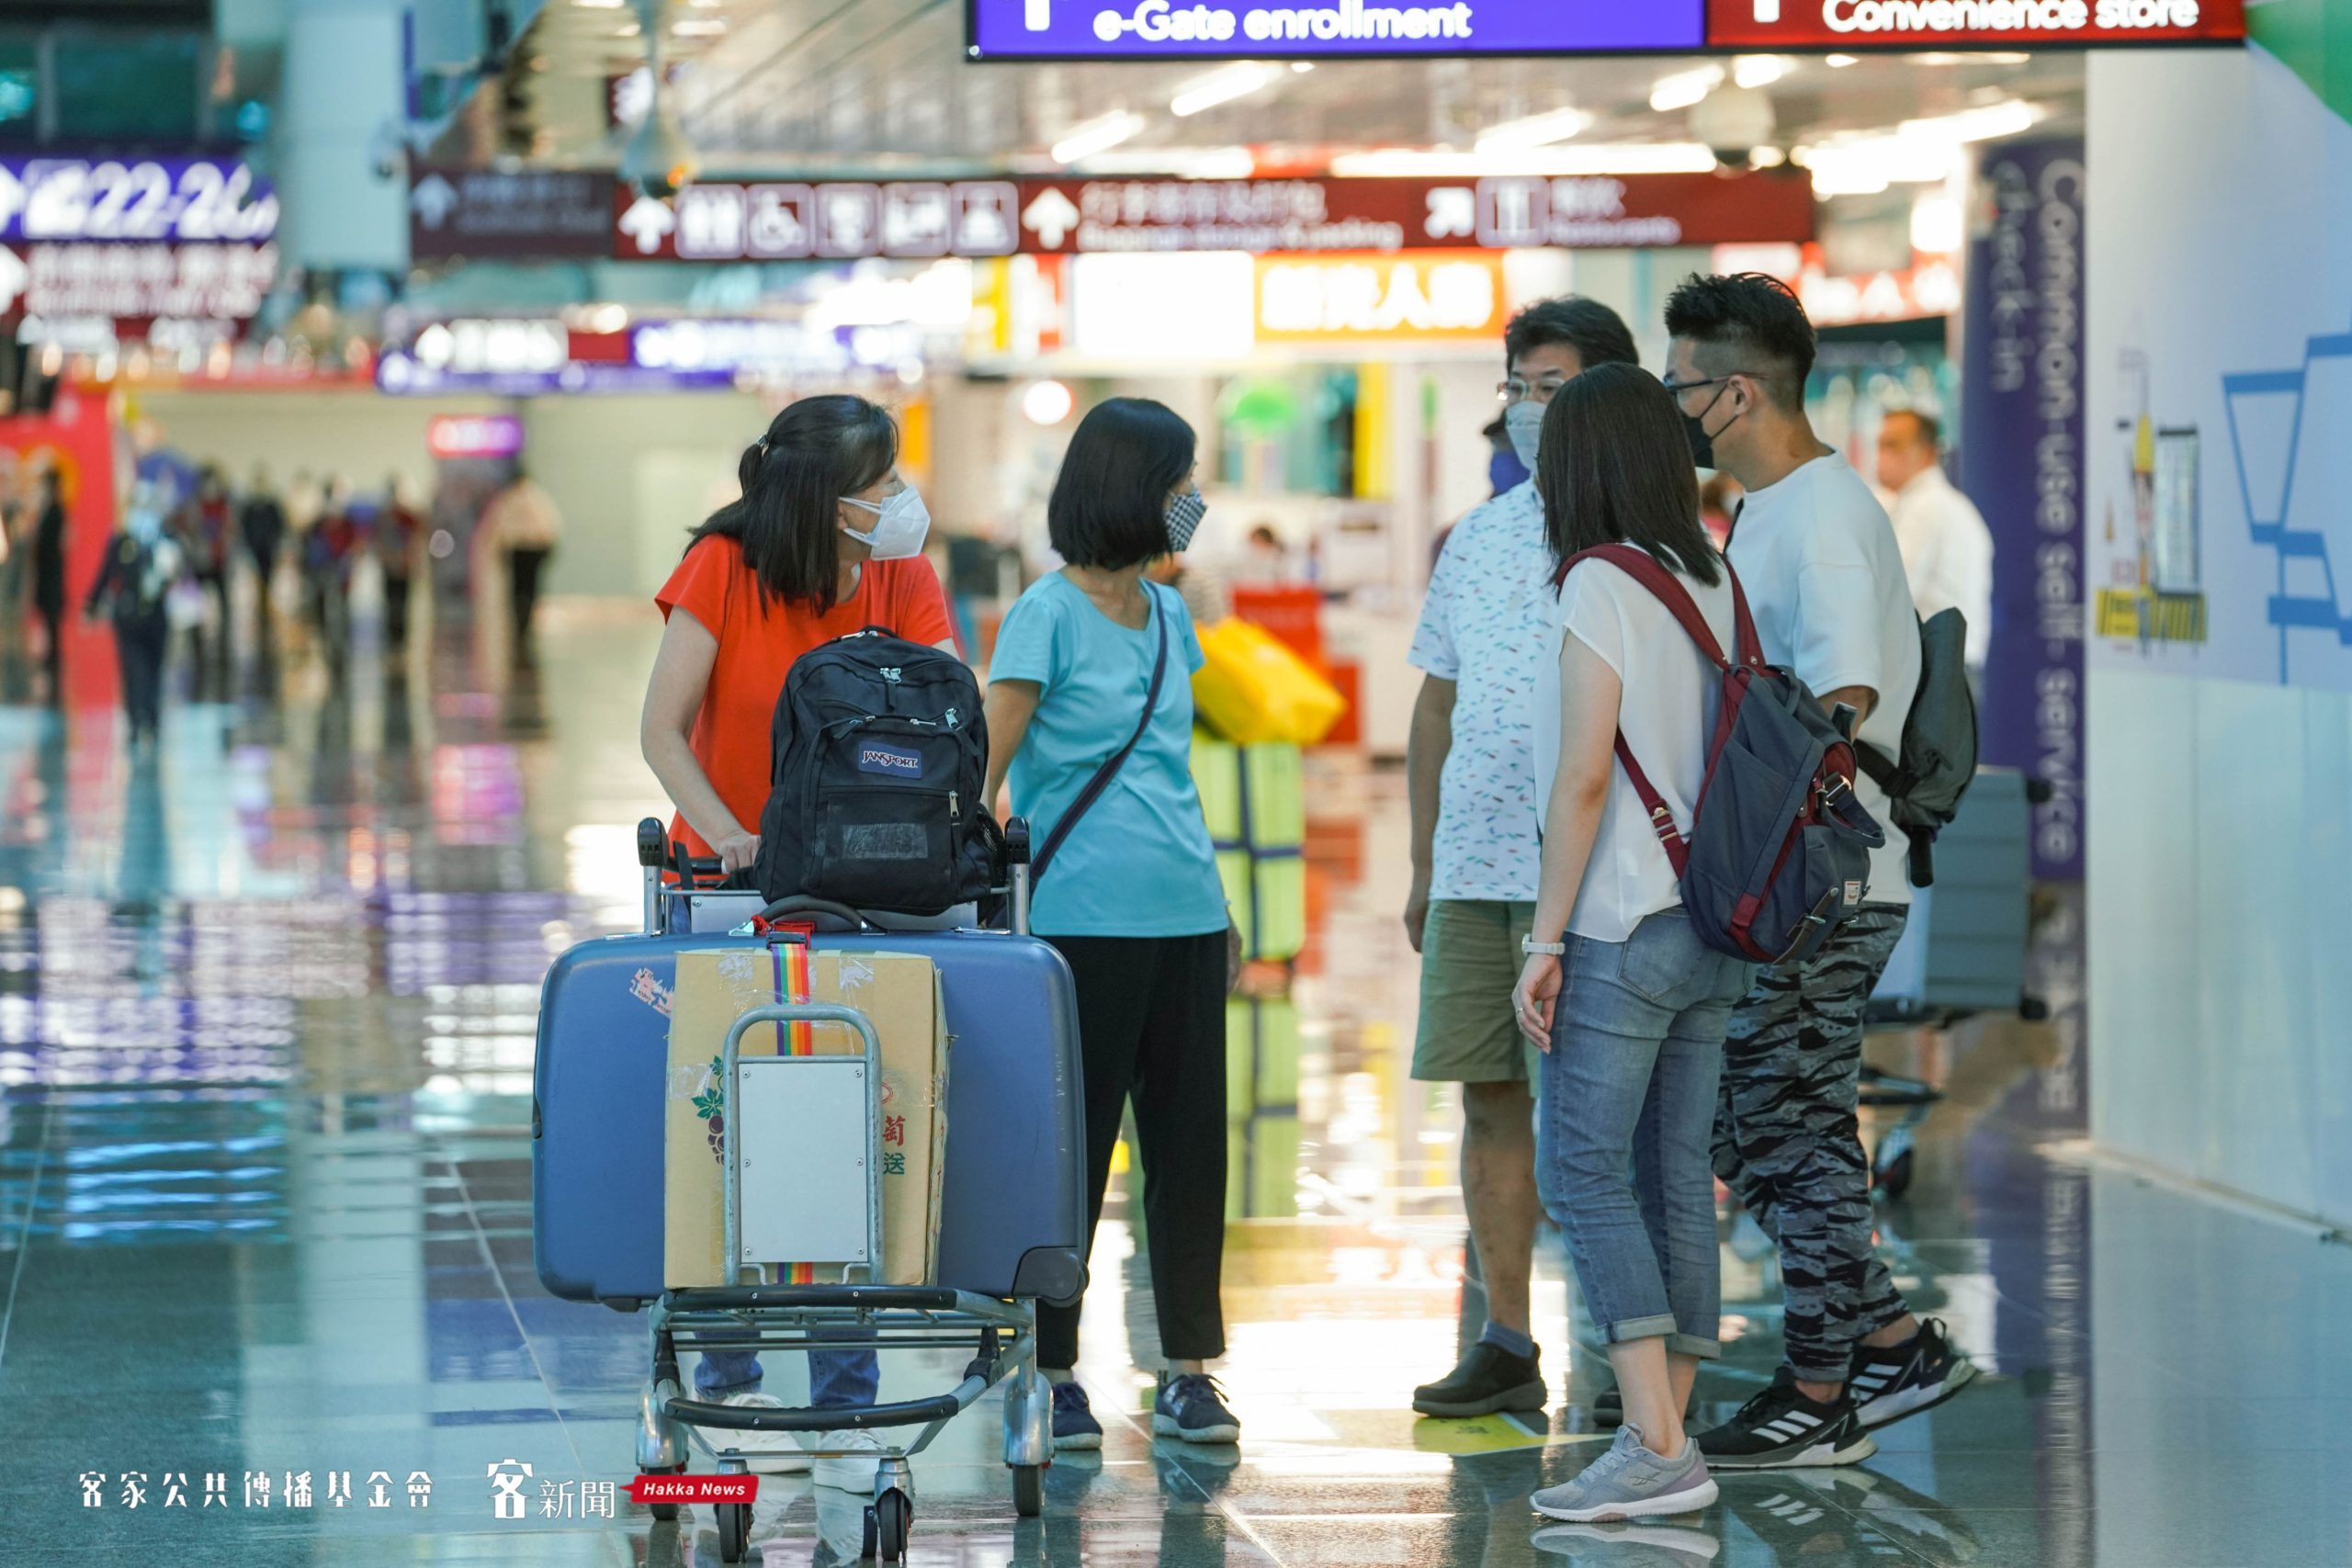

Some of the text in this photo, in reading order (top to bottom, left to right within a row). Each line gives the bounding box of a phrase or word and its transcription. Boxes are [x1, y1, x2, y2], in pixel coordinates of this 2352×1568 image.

[1093, 0, 1473, 41] e-Gate enrollment
[1822, 0, 2199, 32] Convenience store
